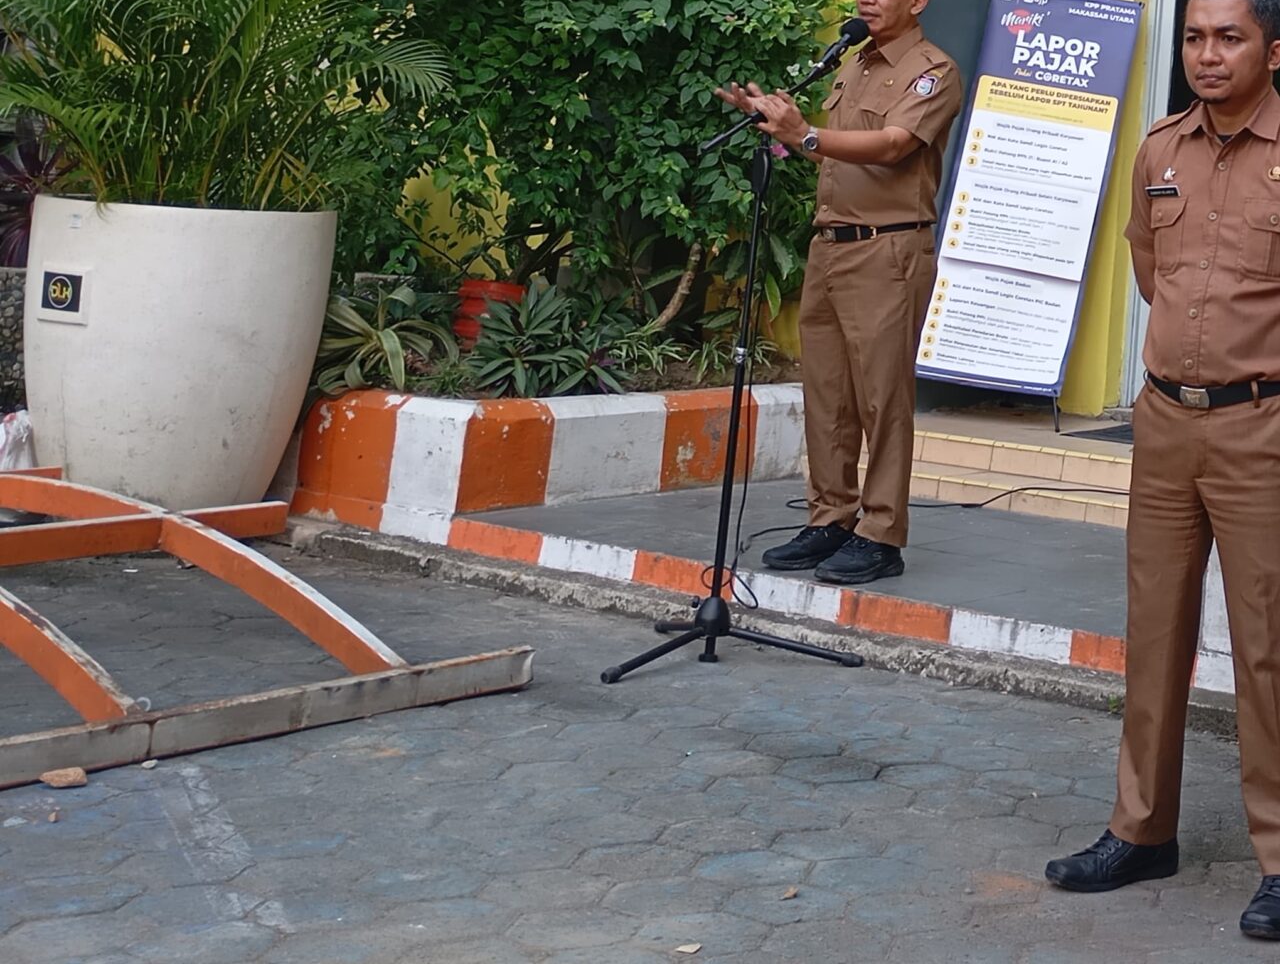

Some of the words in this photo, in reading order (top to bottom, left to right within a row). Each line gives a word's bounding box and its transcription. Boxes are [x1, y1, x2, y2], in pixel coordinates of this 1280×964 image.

[1068, 8, 1109, 19] MAKASSAR
[1110, 15, 1134, 24] UTARA
[1084, 1, 1100, 9] KPP
[1101, 4, 1136, 15] PRATAMA
[1016, 30, 1100, 59] LAPOR
[1012, 47, 1099, 78] PAJAK
[1035, 71, 1089, 88] CORETAX
[990, 88, 1024, 100] SEBELUM
[1026, 95, 1051, 104] LAPOR
[1052, 99, 1066, 107] SPT
[991, 81, 1007, 89] APA
[1009, 84, 1029, 93] YANG
[1031, 87, 1055, 97] PERLU
[1056, 92, 1111, 106] DIPERSIAPKAN
